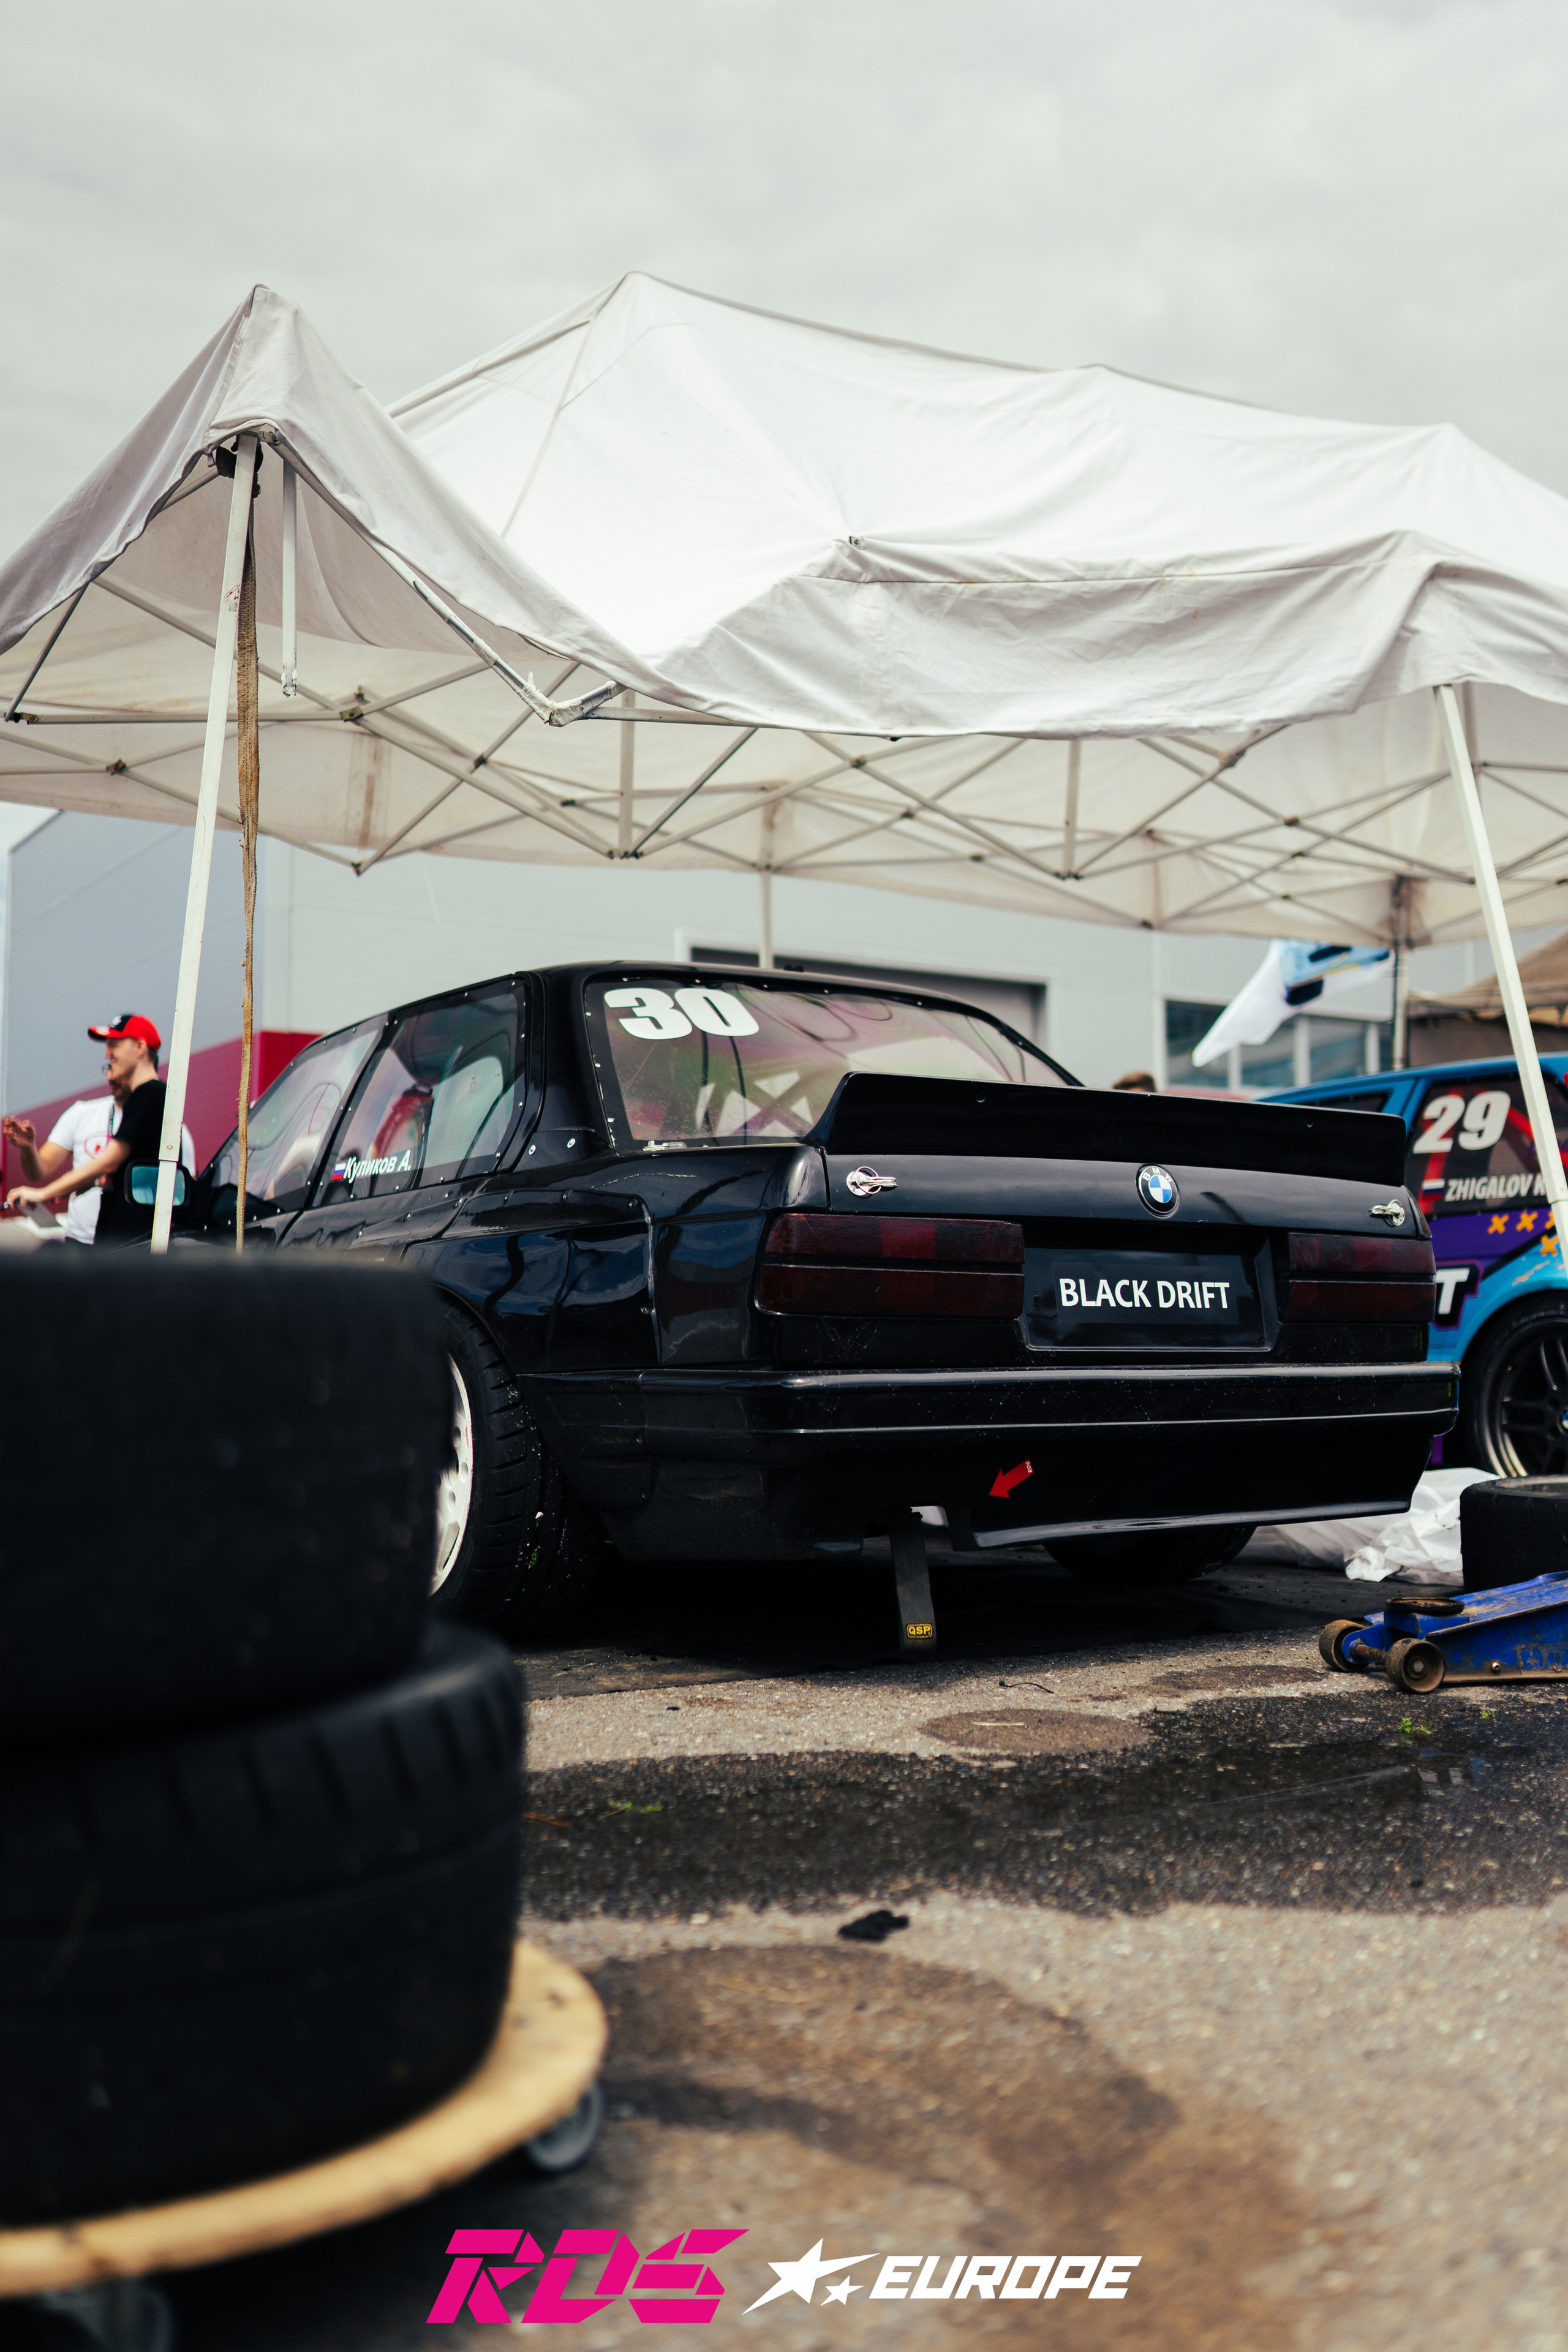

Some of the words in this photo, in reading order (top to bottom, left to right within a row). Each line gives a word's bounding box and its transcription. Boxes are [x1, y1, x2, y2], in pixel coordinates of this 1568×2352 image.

[604, 987, 760, 1040] 30
[1413, 1090, 1511, 1154] 29
[343, 1156, 398, 1183] Куликов
[1142, 1167, 1172, 1182] BMW
[1444, 1173, 1534, 1202] ZHIGALOV
[1059, 1278, 1152, 1308] BLACK
[1156, 1281, 1230, 1309] DRIFT
